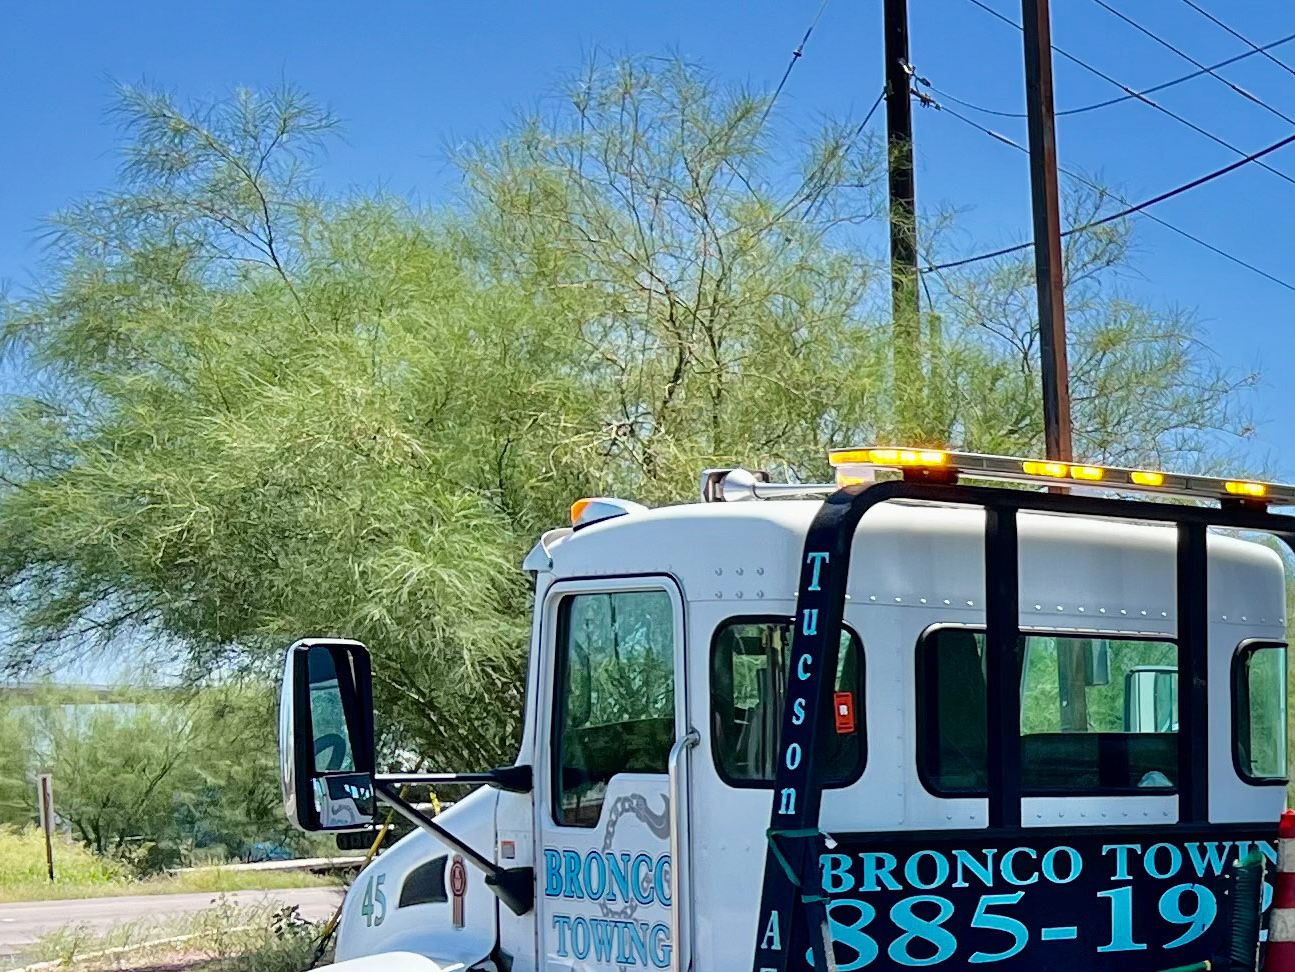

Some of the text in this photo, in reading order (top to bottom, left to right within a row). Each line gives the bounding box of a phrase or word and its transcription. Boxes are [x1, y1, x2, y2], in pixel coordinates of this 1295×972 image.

[778, 551, 830, 815] Tucson
[544, 848, 673, 907] BRONCO
[819, 845, 1083, 893] BRONCO
[361, 873, 387, 928] 45
[552, 915, 673, 969] TOWING
